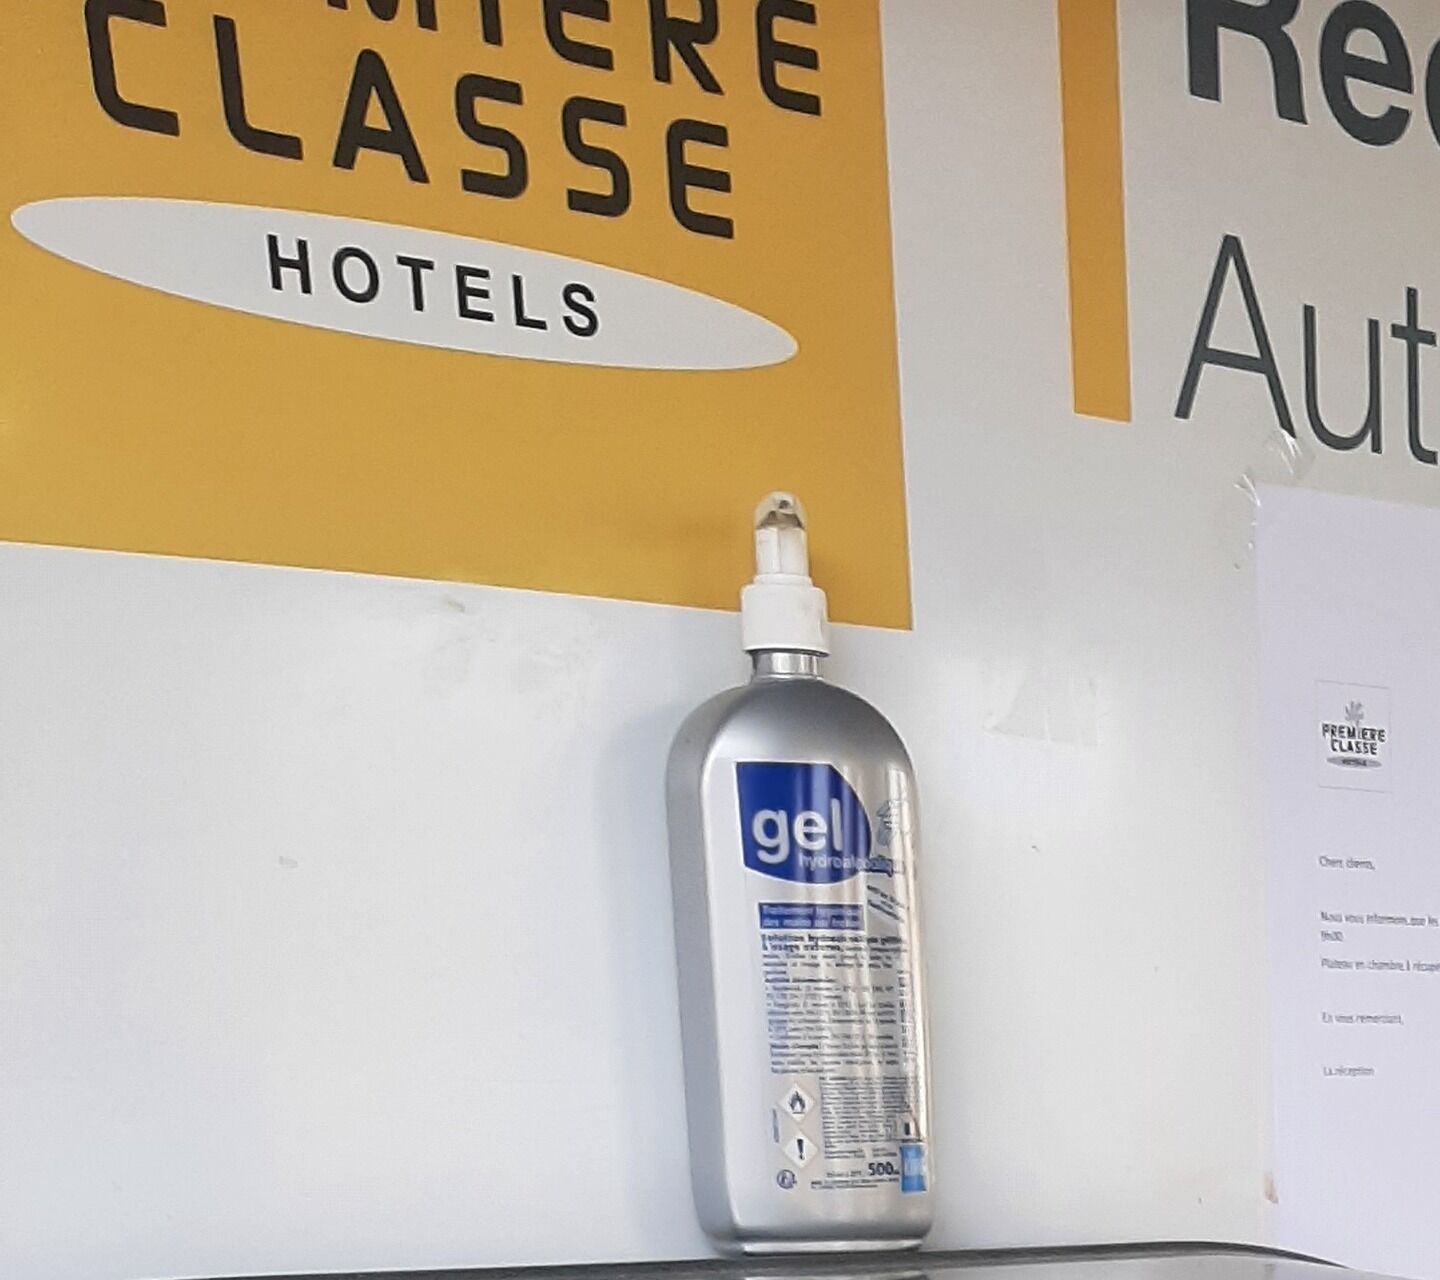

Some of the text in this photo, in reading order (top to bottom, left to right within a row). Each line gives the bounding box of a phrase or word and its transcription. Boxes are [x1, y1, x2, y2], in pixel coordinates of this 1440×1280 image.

[87, 0, 735, 241] CLASSE
[267, 234, 600, 338] HOTELS
[1331, 738, 1377, 755] CLASSE
[752, 798, 844, 864] gel
